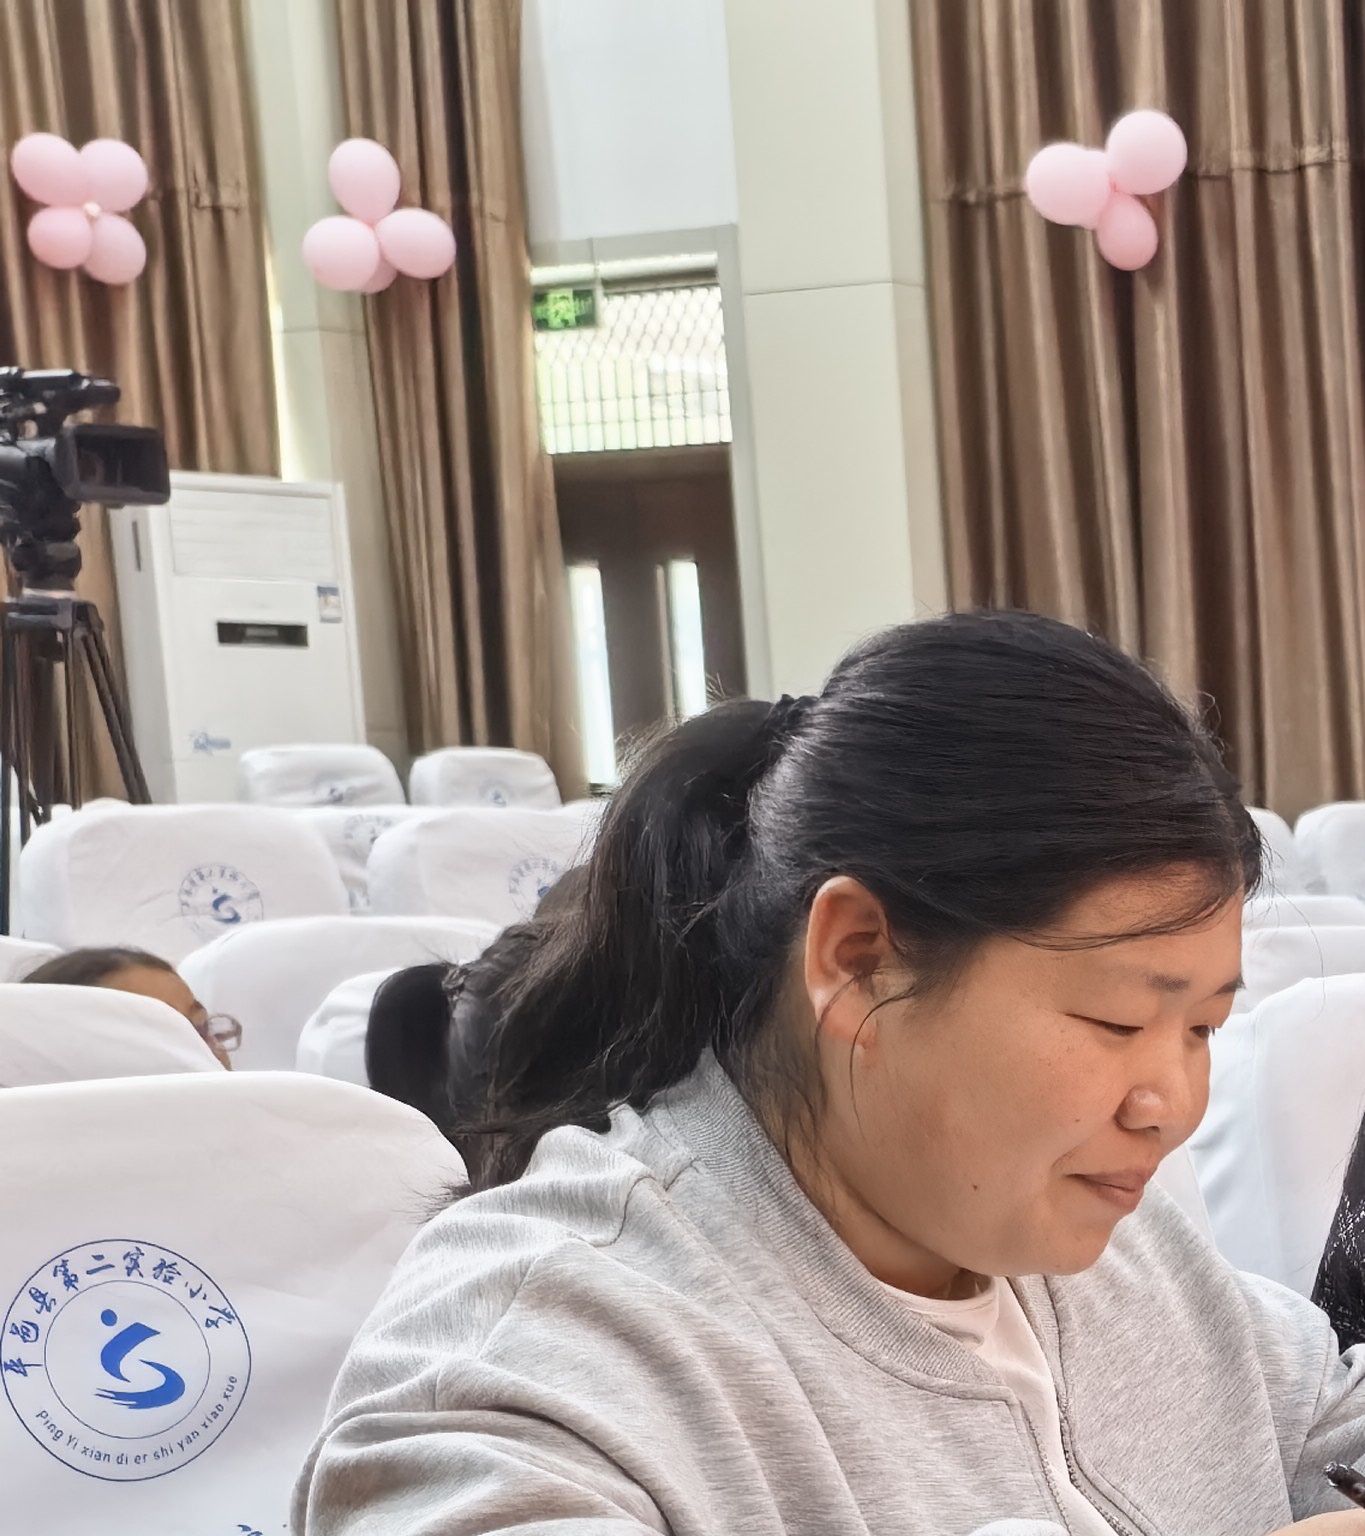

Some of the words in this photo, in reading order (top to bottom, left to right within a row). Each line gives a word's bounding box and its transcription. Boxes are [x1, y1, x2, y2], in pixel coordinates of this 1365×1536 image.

[81, 1444, 112, 1465] xian
[116, 1452, 129, 1465] di
[134, 1453, 148, 1465] er
[153, 1444, 175, 1460] shi
[200, 1402, 226, 1430] xiao
